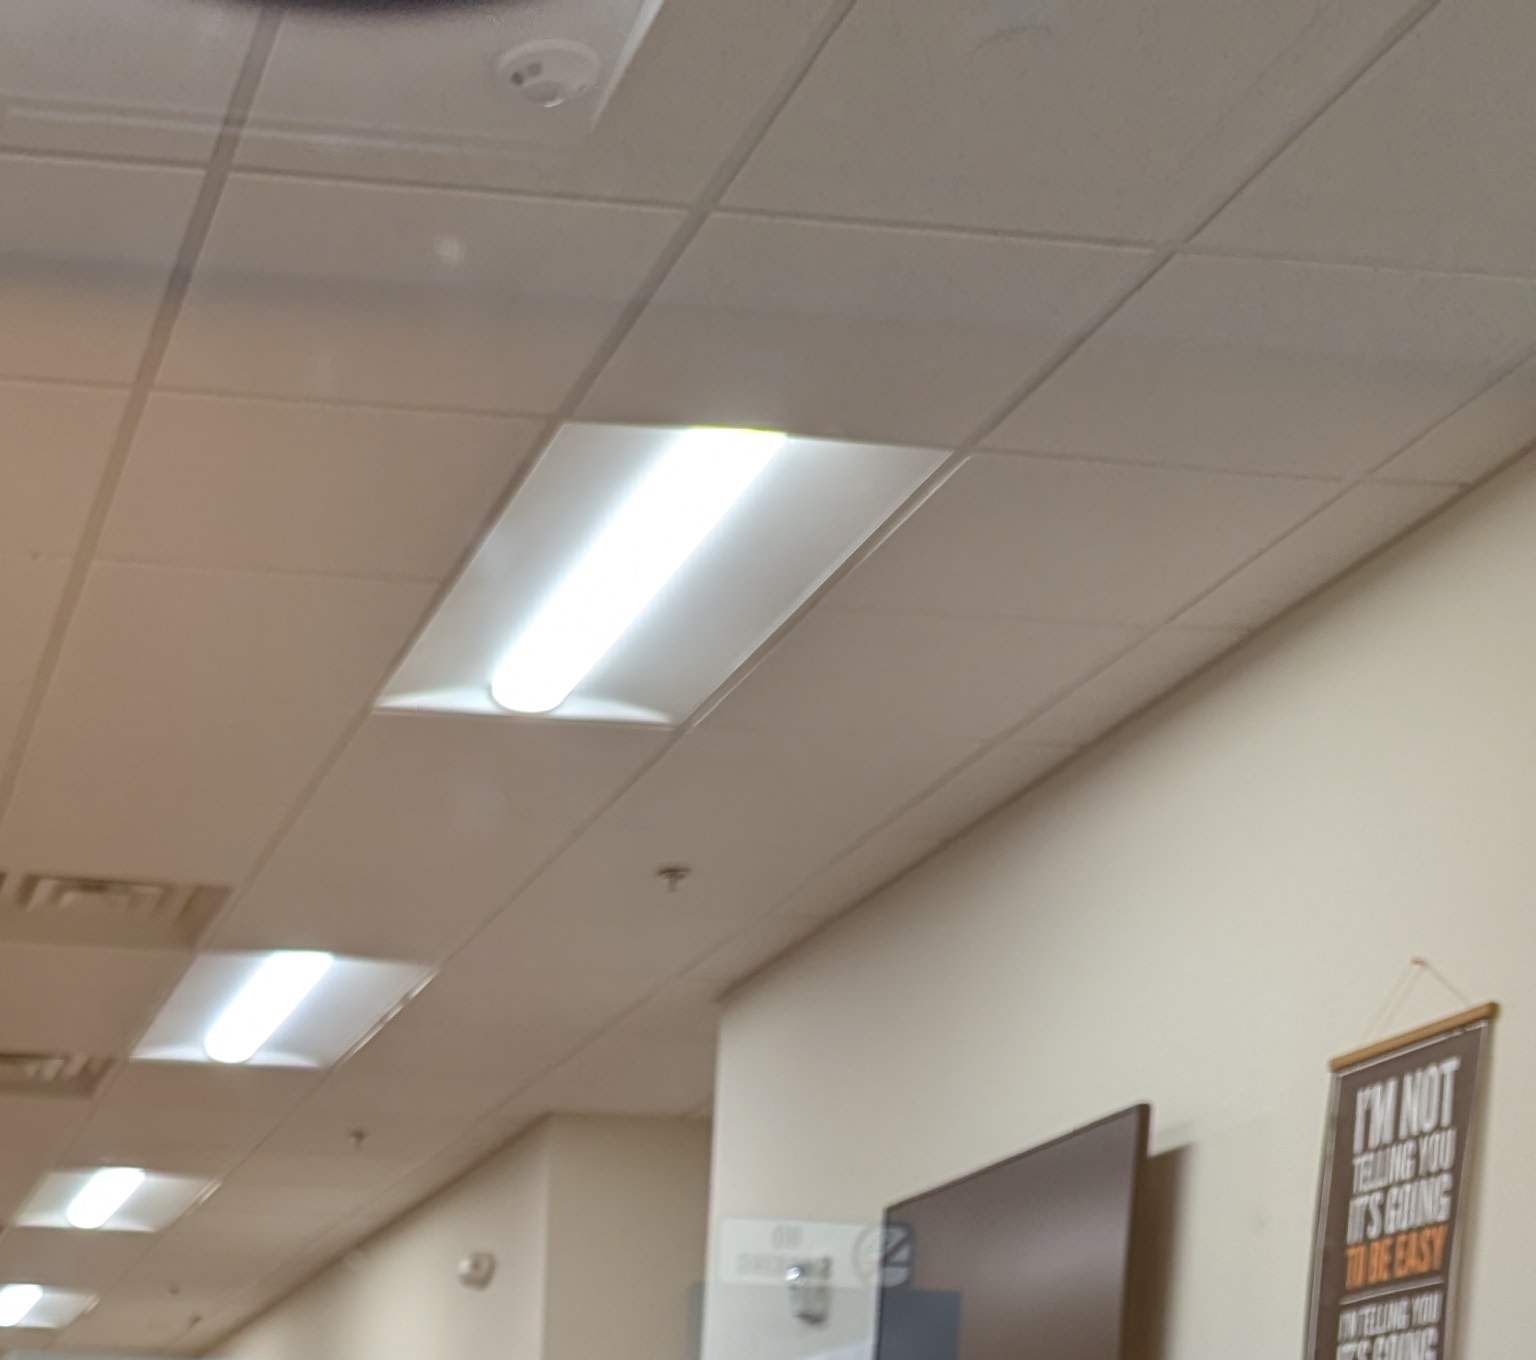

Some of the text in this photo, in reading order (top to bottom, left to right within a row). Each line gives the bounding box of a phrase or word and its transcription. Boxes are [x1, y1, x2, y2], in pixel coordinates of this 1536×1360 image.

[1354, 1057, 1460, 1152] I'M NOT
[1353, 1128, 1456, 1192] TELLING YOU
[1347, 1174, 1452, 1243] IT'S GOING
[1346, 1225, 1447, 1288] TO BE EASY
[1358, 1298, 1409, 1335] TELLING
[1412, 1292, 1442, 1323] YOU
